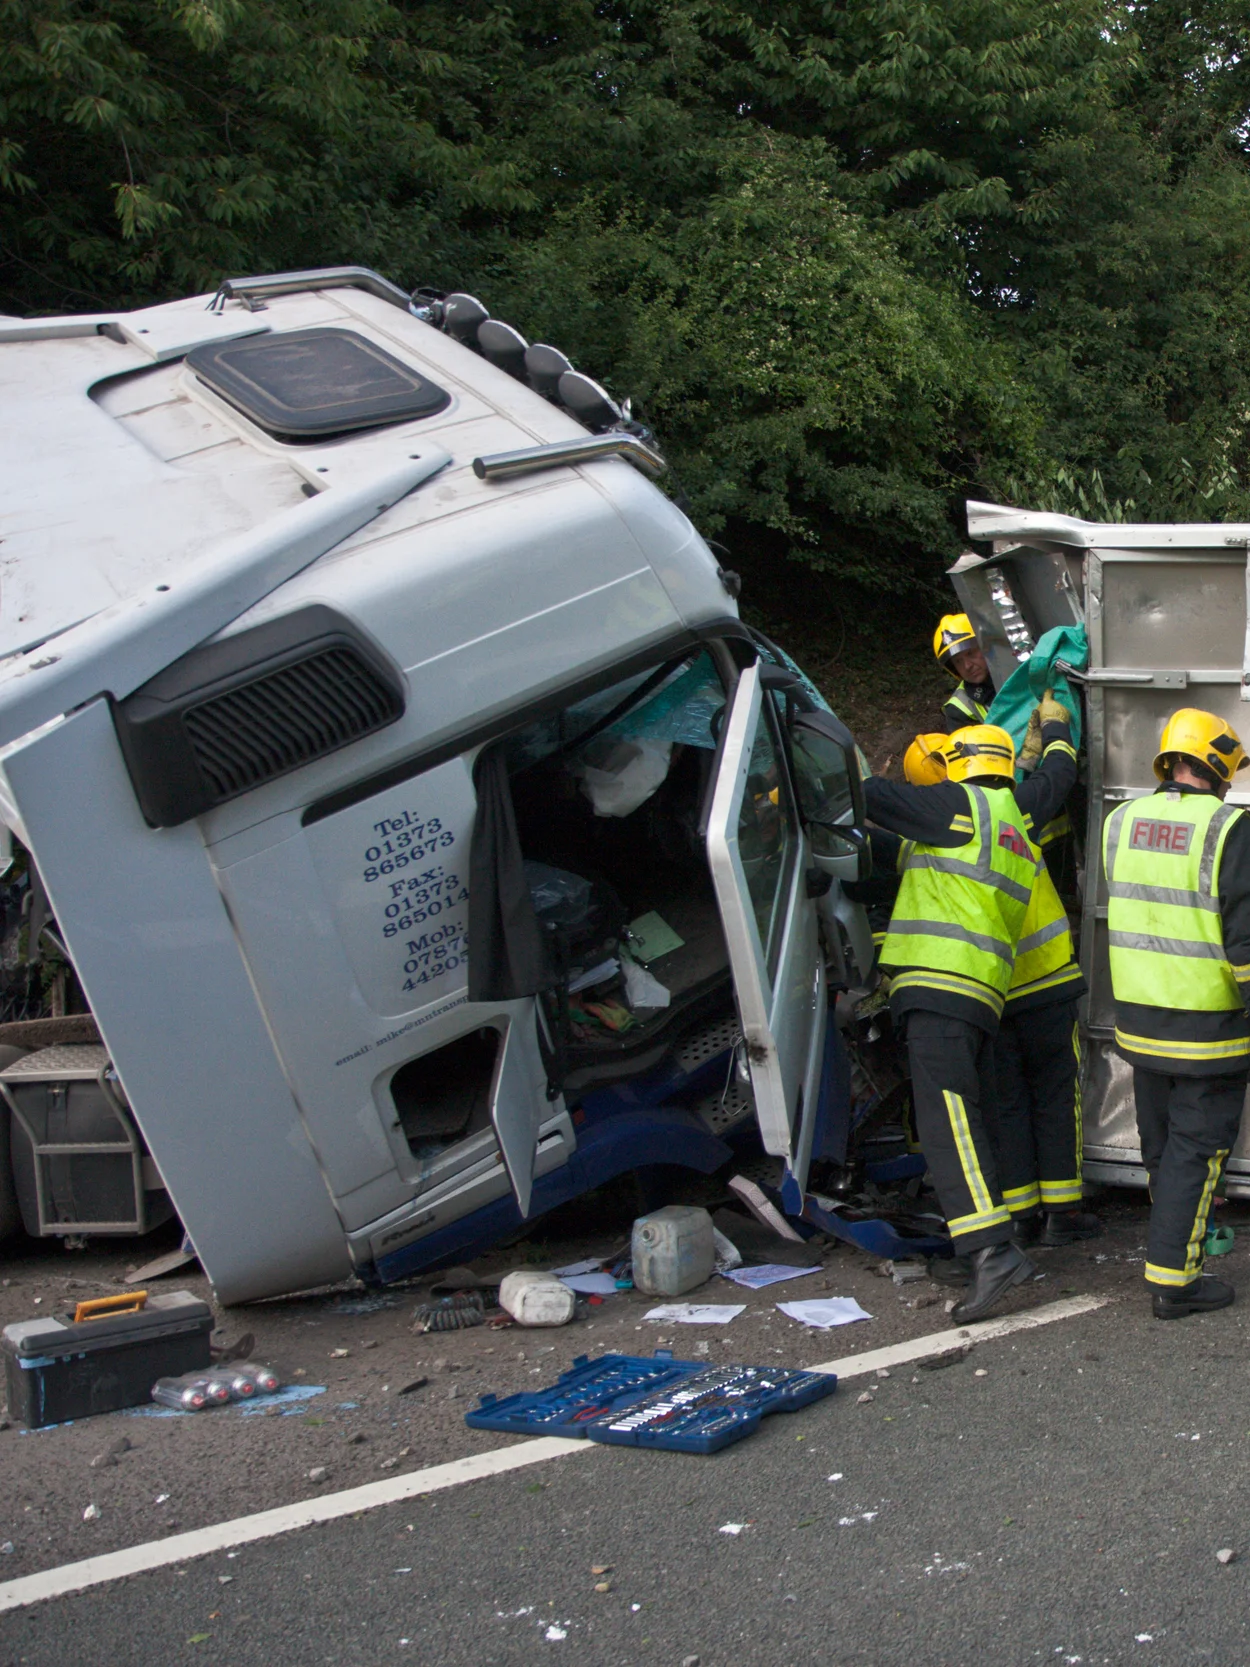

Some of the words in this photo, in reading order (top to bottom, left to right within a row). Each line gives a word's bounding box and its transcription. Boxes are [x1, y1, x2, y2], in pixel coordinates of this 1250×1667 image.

[365, 818, 442, 862] 01373
[373, 811, 420, 838] Tel:
[1133, 821, 1188, 850] FIRE
[363, 831, 455, 882] 865673
[385, 875, 459, 918] 01373
[388, 866, 444, 899] Fax:
[382, 887, 470, 938] 865014
[406, 922, 463, 956] Mob:
[335, 1044, 373, 1067] email:
